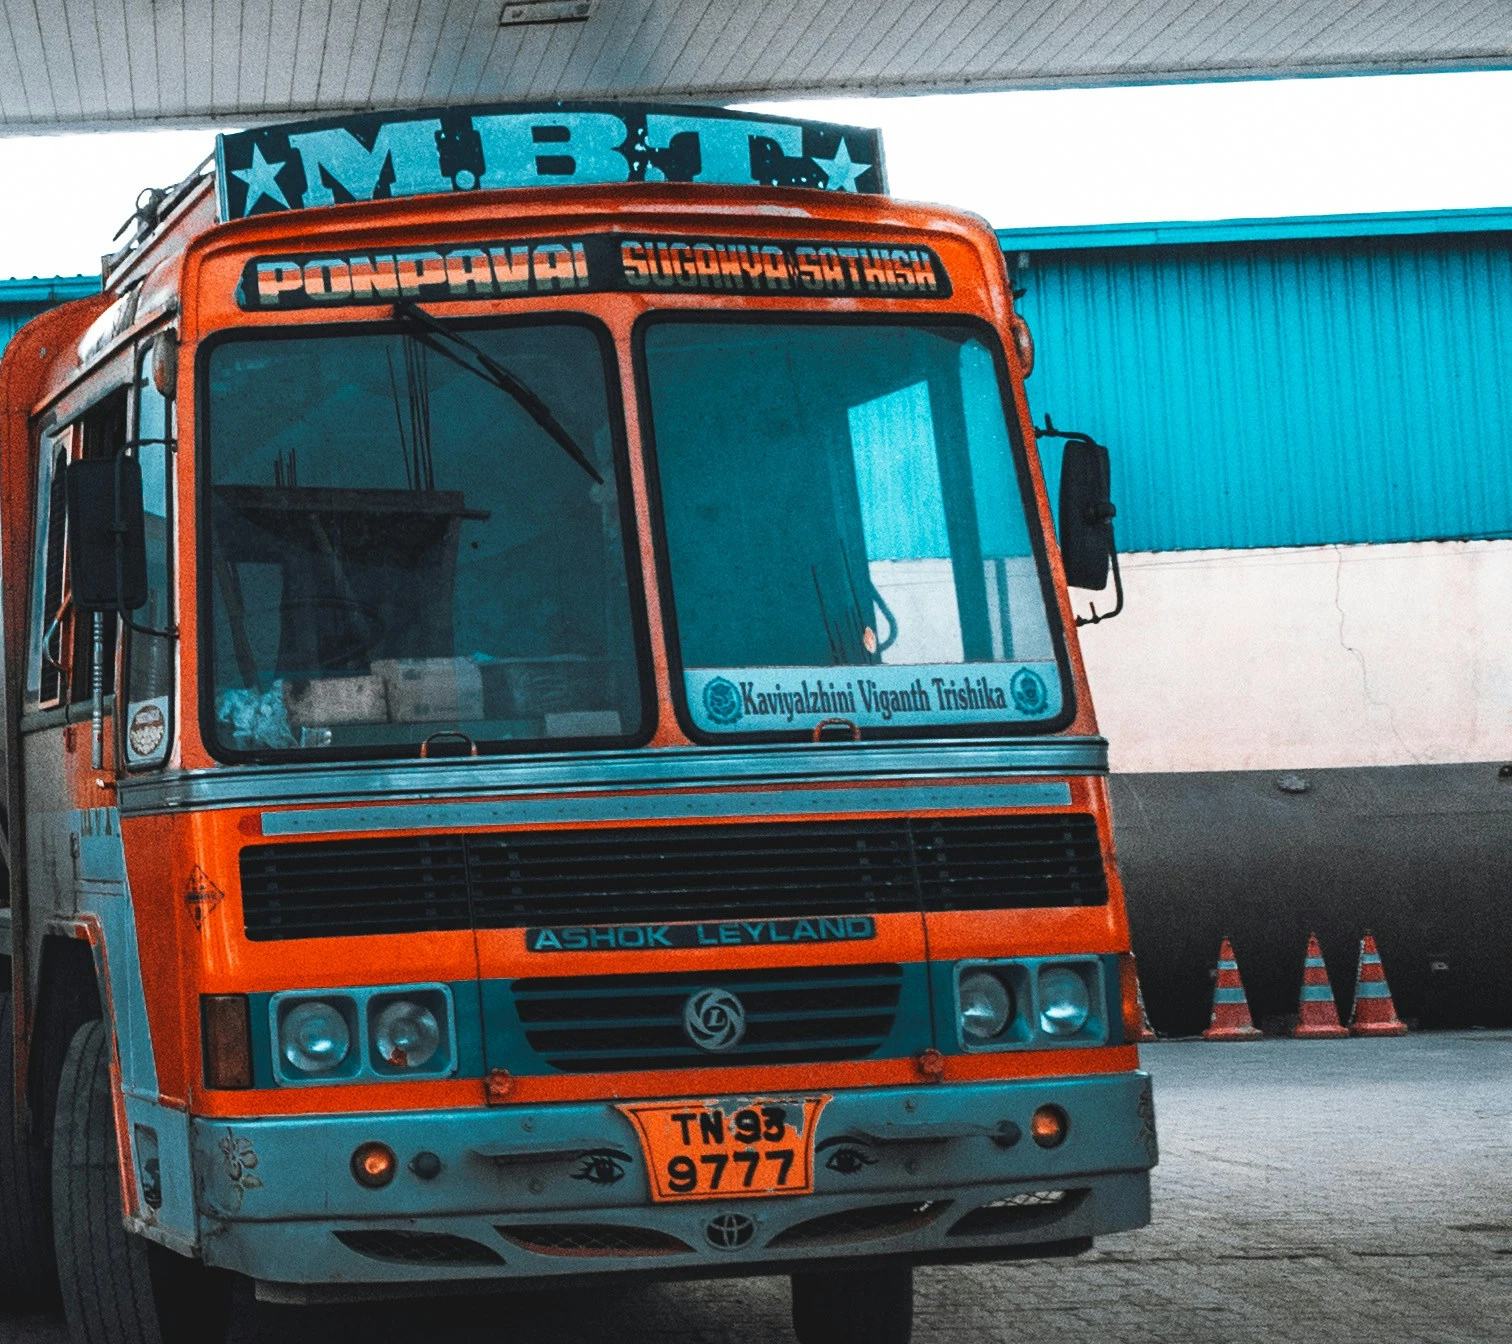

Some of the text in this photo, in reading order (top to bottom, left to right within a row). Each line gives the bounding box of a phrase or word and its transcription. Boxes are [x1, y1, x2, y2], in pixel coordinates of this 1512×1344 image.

[257, 241, 589, 305] PONPAVAI
[740, 675, 1008, 723] Kaviyalzhini Viganth Trishika
[534, 916, 875, 950] ASHOK LEYLAND
[671, 1106, 787, 1146] TN 93
[667, 1149, 795, 1193] 9777
